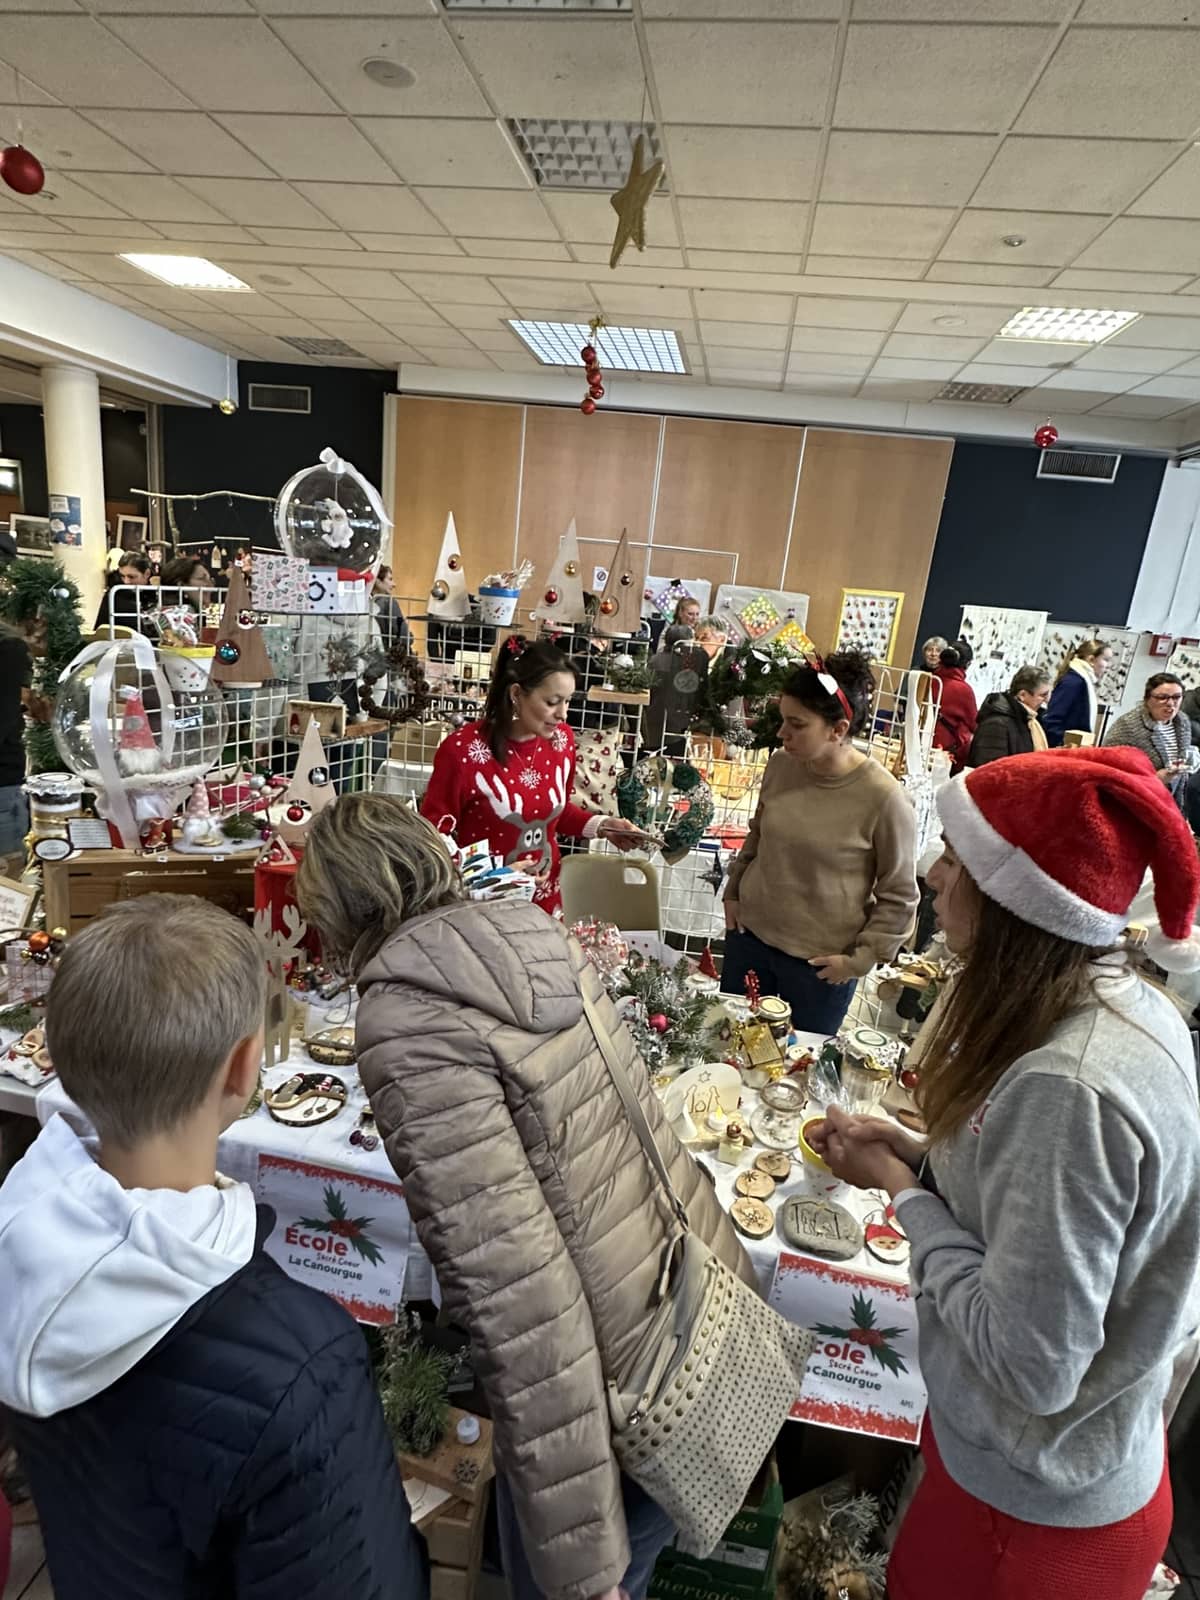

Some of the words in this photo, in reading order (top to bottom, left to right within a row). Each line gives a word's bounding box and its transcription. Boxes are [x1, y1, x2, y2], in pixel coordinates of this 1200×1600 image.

[285, 1224, 348, 1255] École
[289, 1255, 300, 1265] La
[303, 1259, 362, 1280] Canourgue
[812, 1367, 881, 1390] Canourgue
